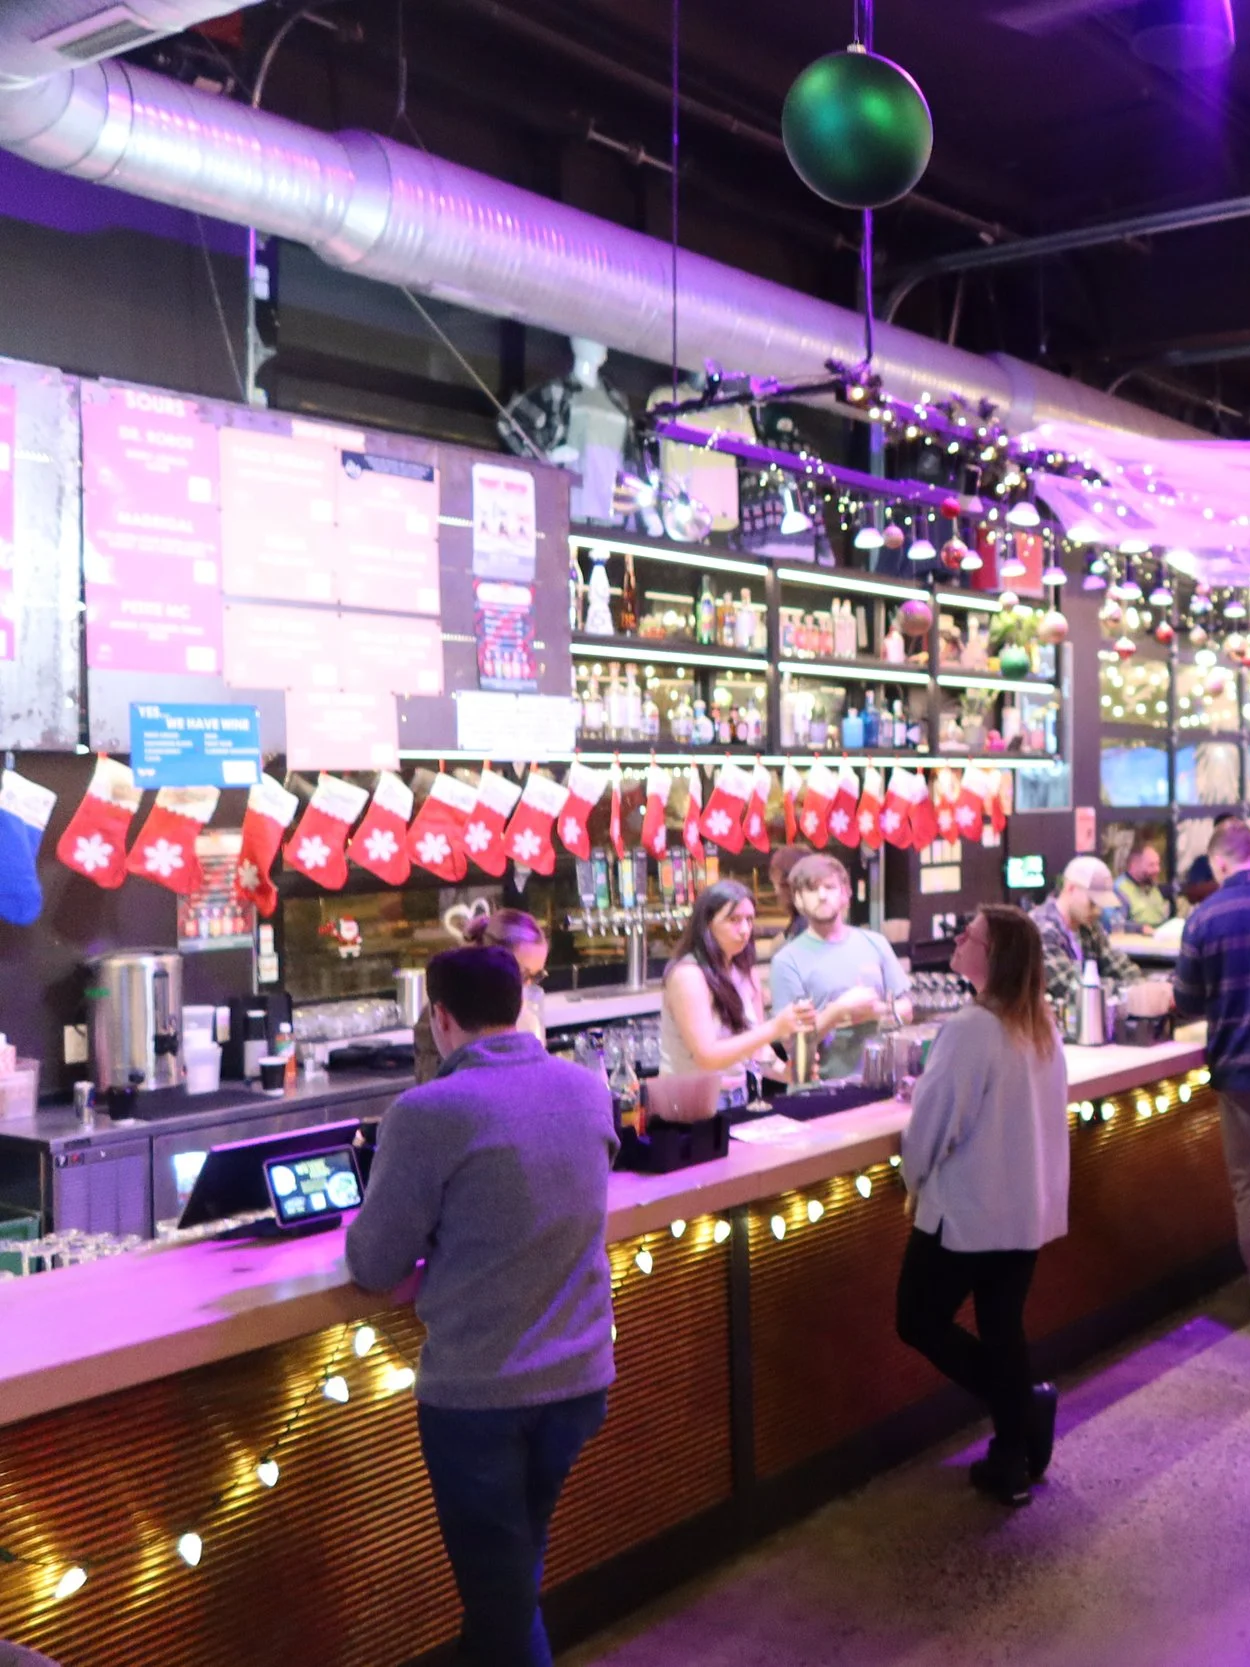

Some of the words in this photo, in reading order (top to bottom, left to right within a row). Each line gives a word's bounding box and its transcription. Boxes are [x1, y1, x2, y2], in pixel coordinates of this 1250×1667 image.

[126, 390, 185, 418] SOURS
[166, 717, 184, 730] WE
[187, 718, 219, 731] HAVE
